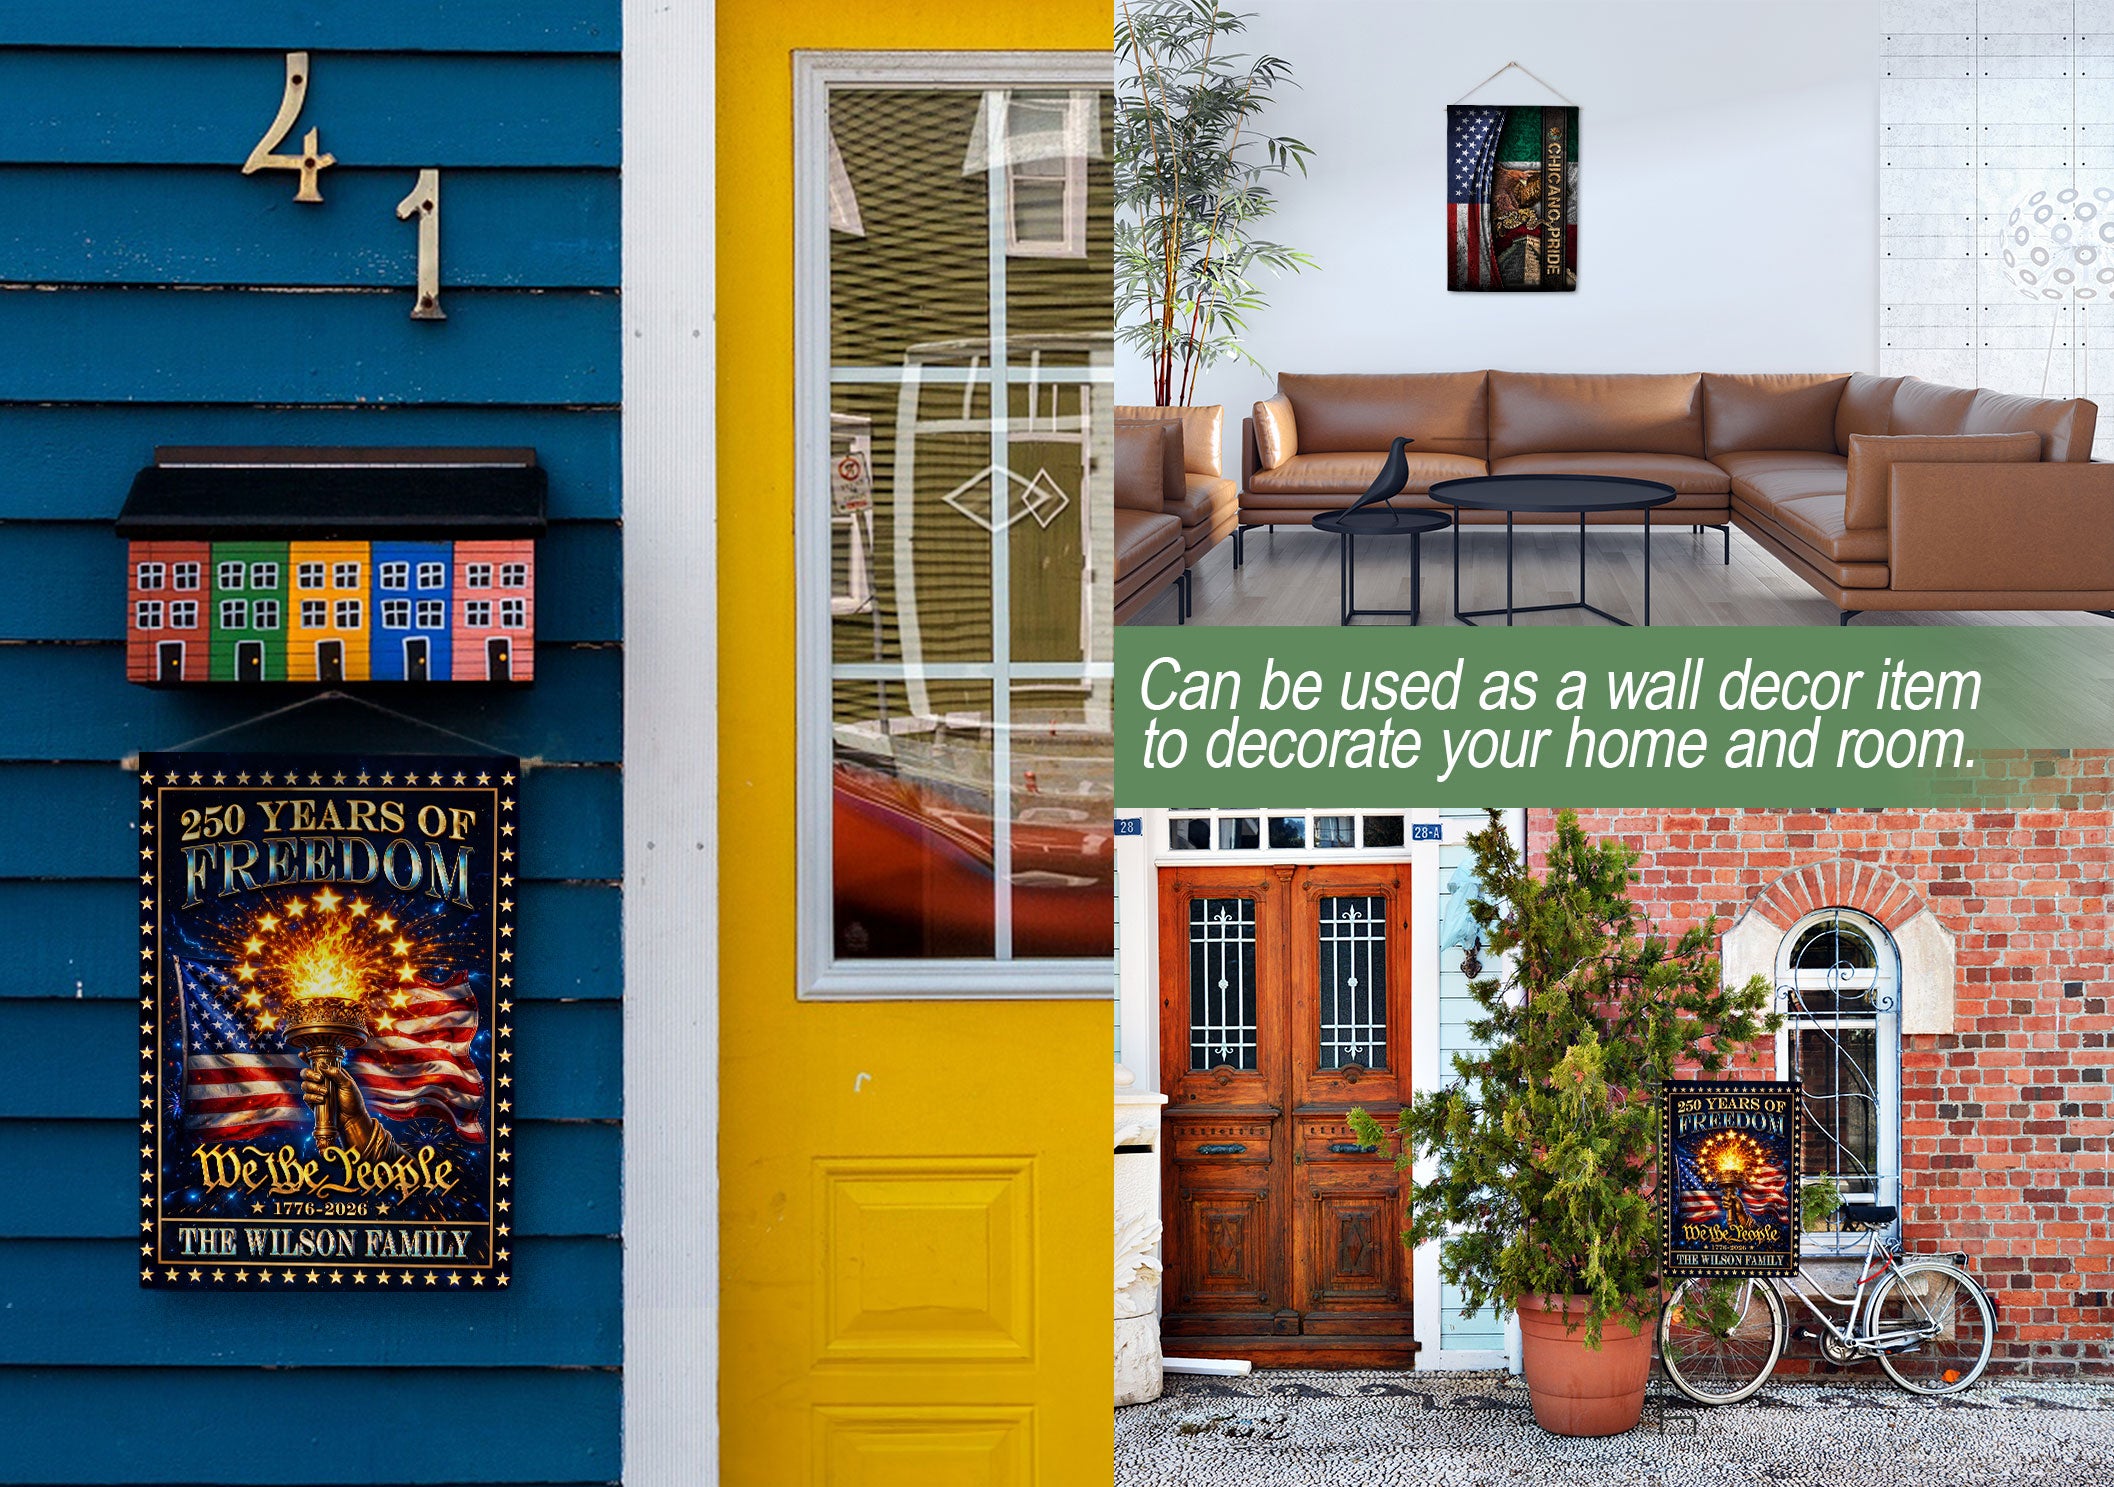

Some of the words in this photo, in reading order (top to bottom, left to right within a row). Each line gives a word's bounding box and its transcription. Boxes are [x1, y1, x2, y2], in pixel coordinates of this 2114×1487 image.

[1547, 143, 1561, 221] CHICANO
[1546, 227, 1561, 275] PRIDE
[180, 803, 246, 841] 250
[256, 799, 405, 833] YEARS
[417, 805, 477, 841] OF
[1120, 821, 1134, 834] 28
[1414, 826, 1440, 839] 28-A
[181, 836, 476, 910] FREEDOM
[1677, 1099, 1702, 1113] 250
[1705, 1097, 1760, 1111] YEARS
[1764, 1099, 1787, 1114] OF
[1678, 1111, 1786, 1138] FREEDOM
[192, 1143, 268, 1195] We
[317, 1145, 459, 1205] People
[273, 1202, 368, 1216] 1776-2026
[179, 1227, 238, 1257] THE
[244, 1227, 356, 1257] WILSON
[364, 1229, 472, 1259] FAMILY
[1682, 1223, 1710, 1242] We
[1727, 1224, 1780, 1246] People
[1676, 1254, 1699, 1265] THE
[1701, 1254, 1742, 1266] WILSON
[1745, 1254, 1784, 1266] FAMILY
